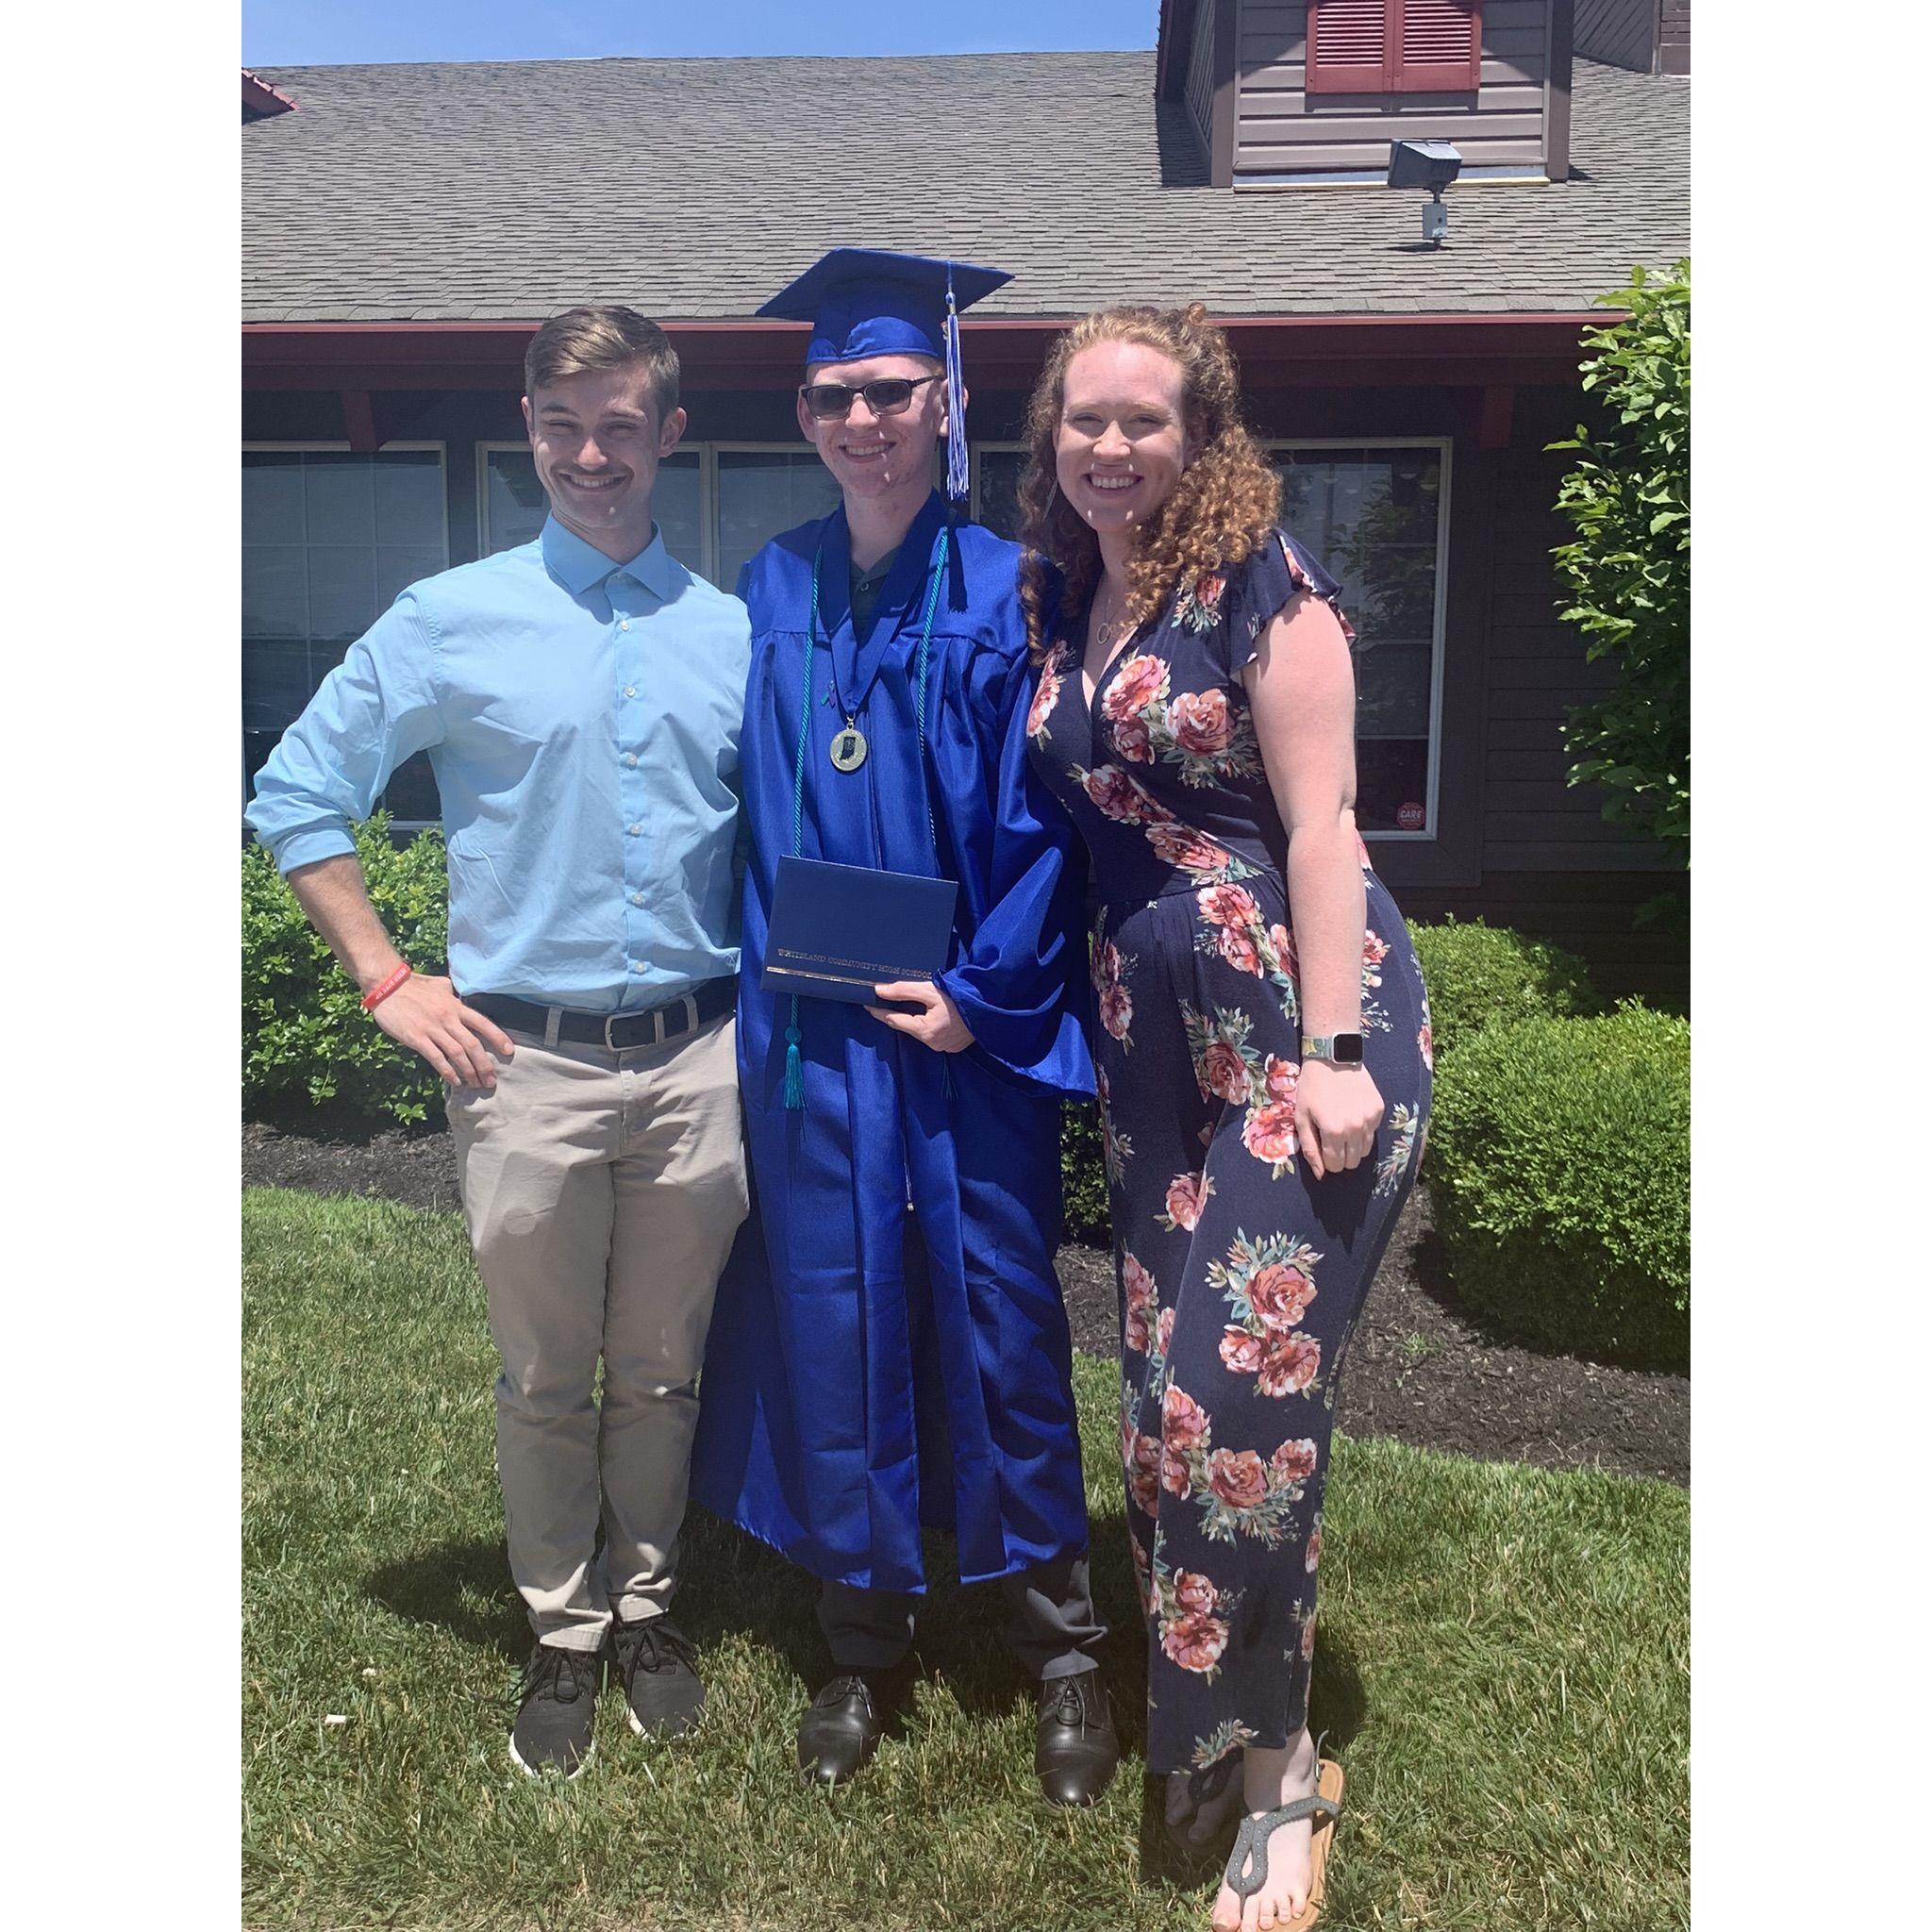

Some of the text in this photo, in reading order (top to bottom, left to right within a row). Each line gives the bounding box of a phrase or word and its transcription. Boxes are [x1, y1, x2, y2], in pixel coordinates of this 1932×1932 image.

[1400, 809, 1423, 819] CARE
[877, 964, 901, 974] HIGH
[900, 968, 933, 980] SCHOOL
